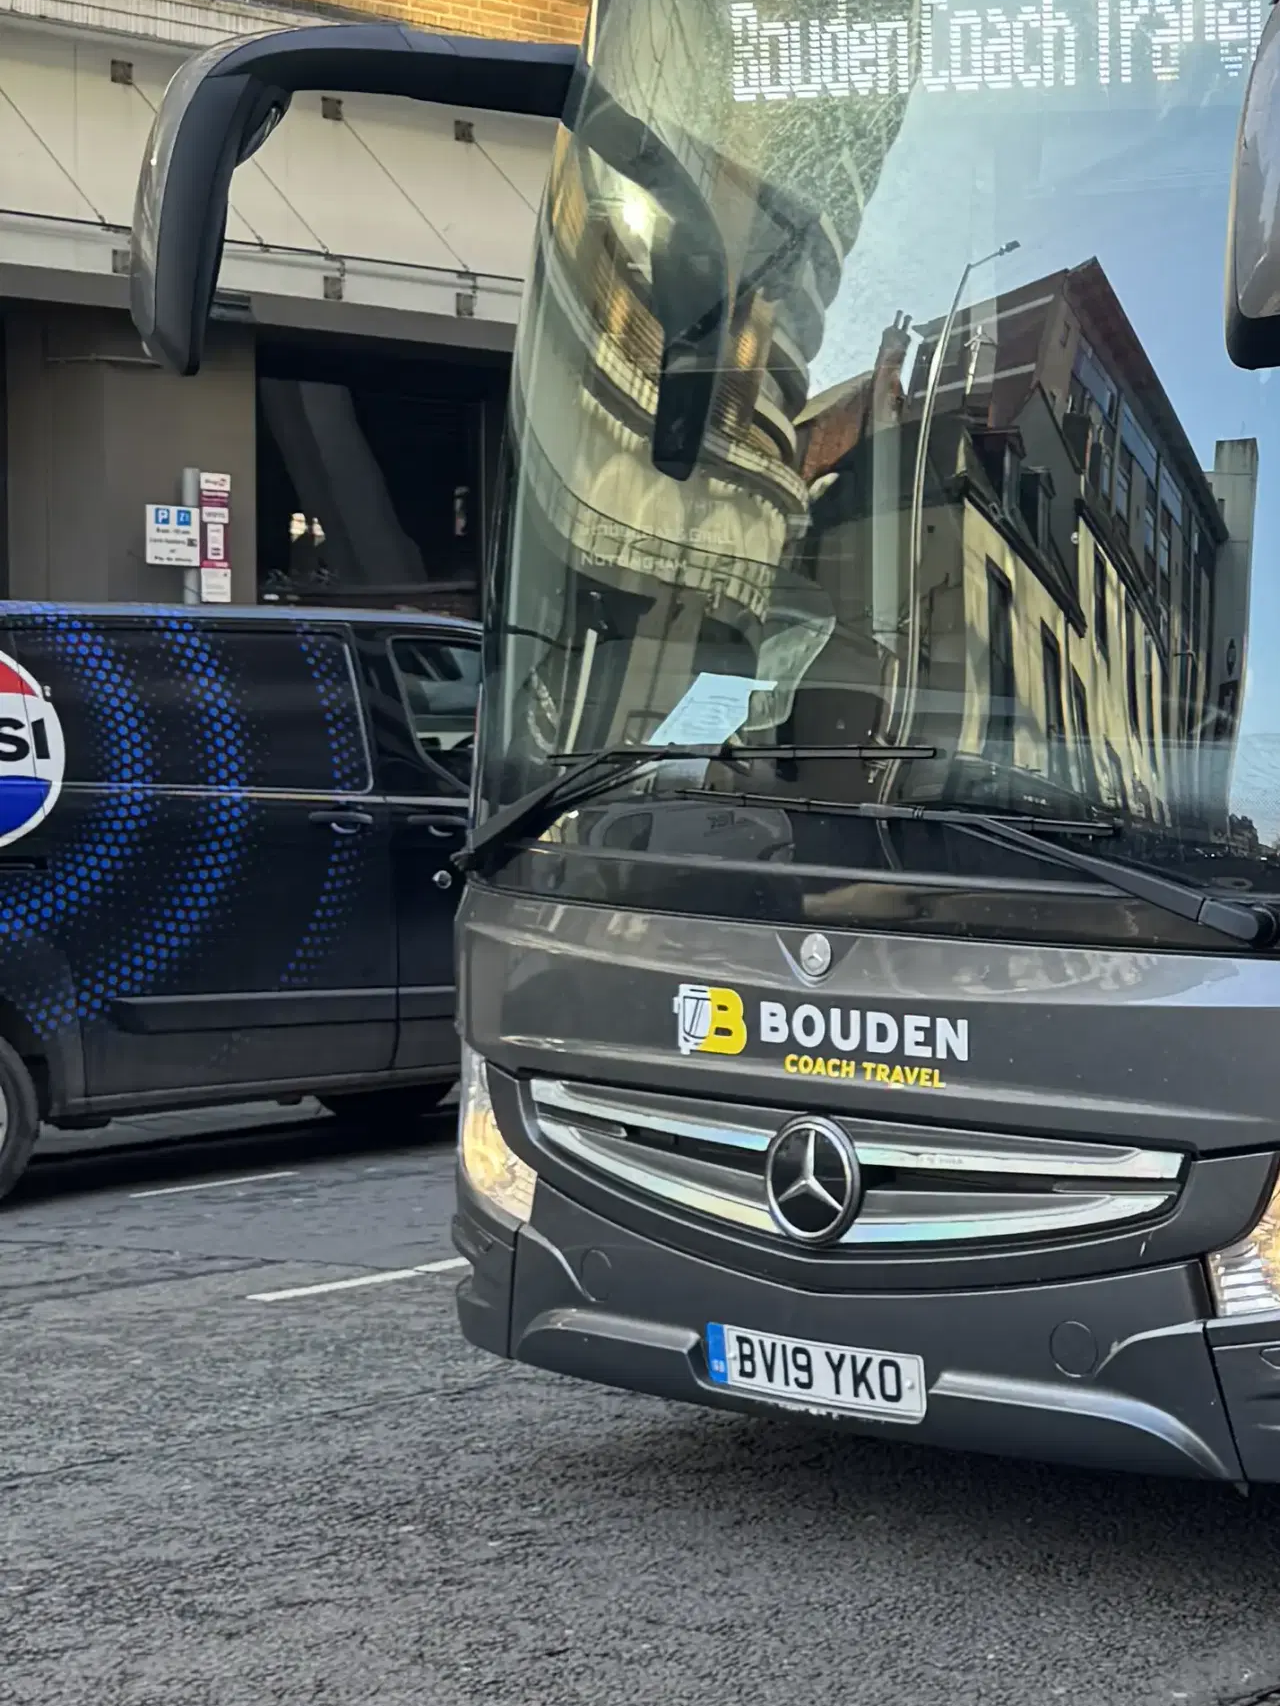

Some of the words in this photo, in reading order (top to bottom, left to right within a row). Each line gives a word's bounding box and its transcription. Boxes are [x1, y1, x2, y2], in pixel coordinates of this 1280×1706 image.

[760, 1000, 970, 1061] BOUDEN
[784, 1053, 856, 1080] COACH
[862, 1062, 946, 1089] TRAVEL
[736, 1335, 814, 1390] BV19
[825, 1351, 902, 1403] YKO
